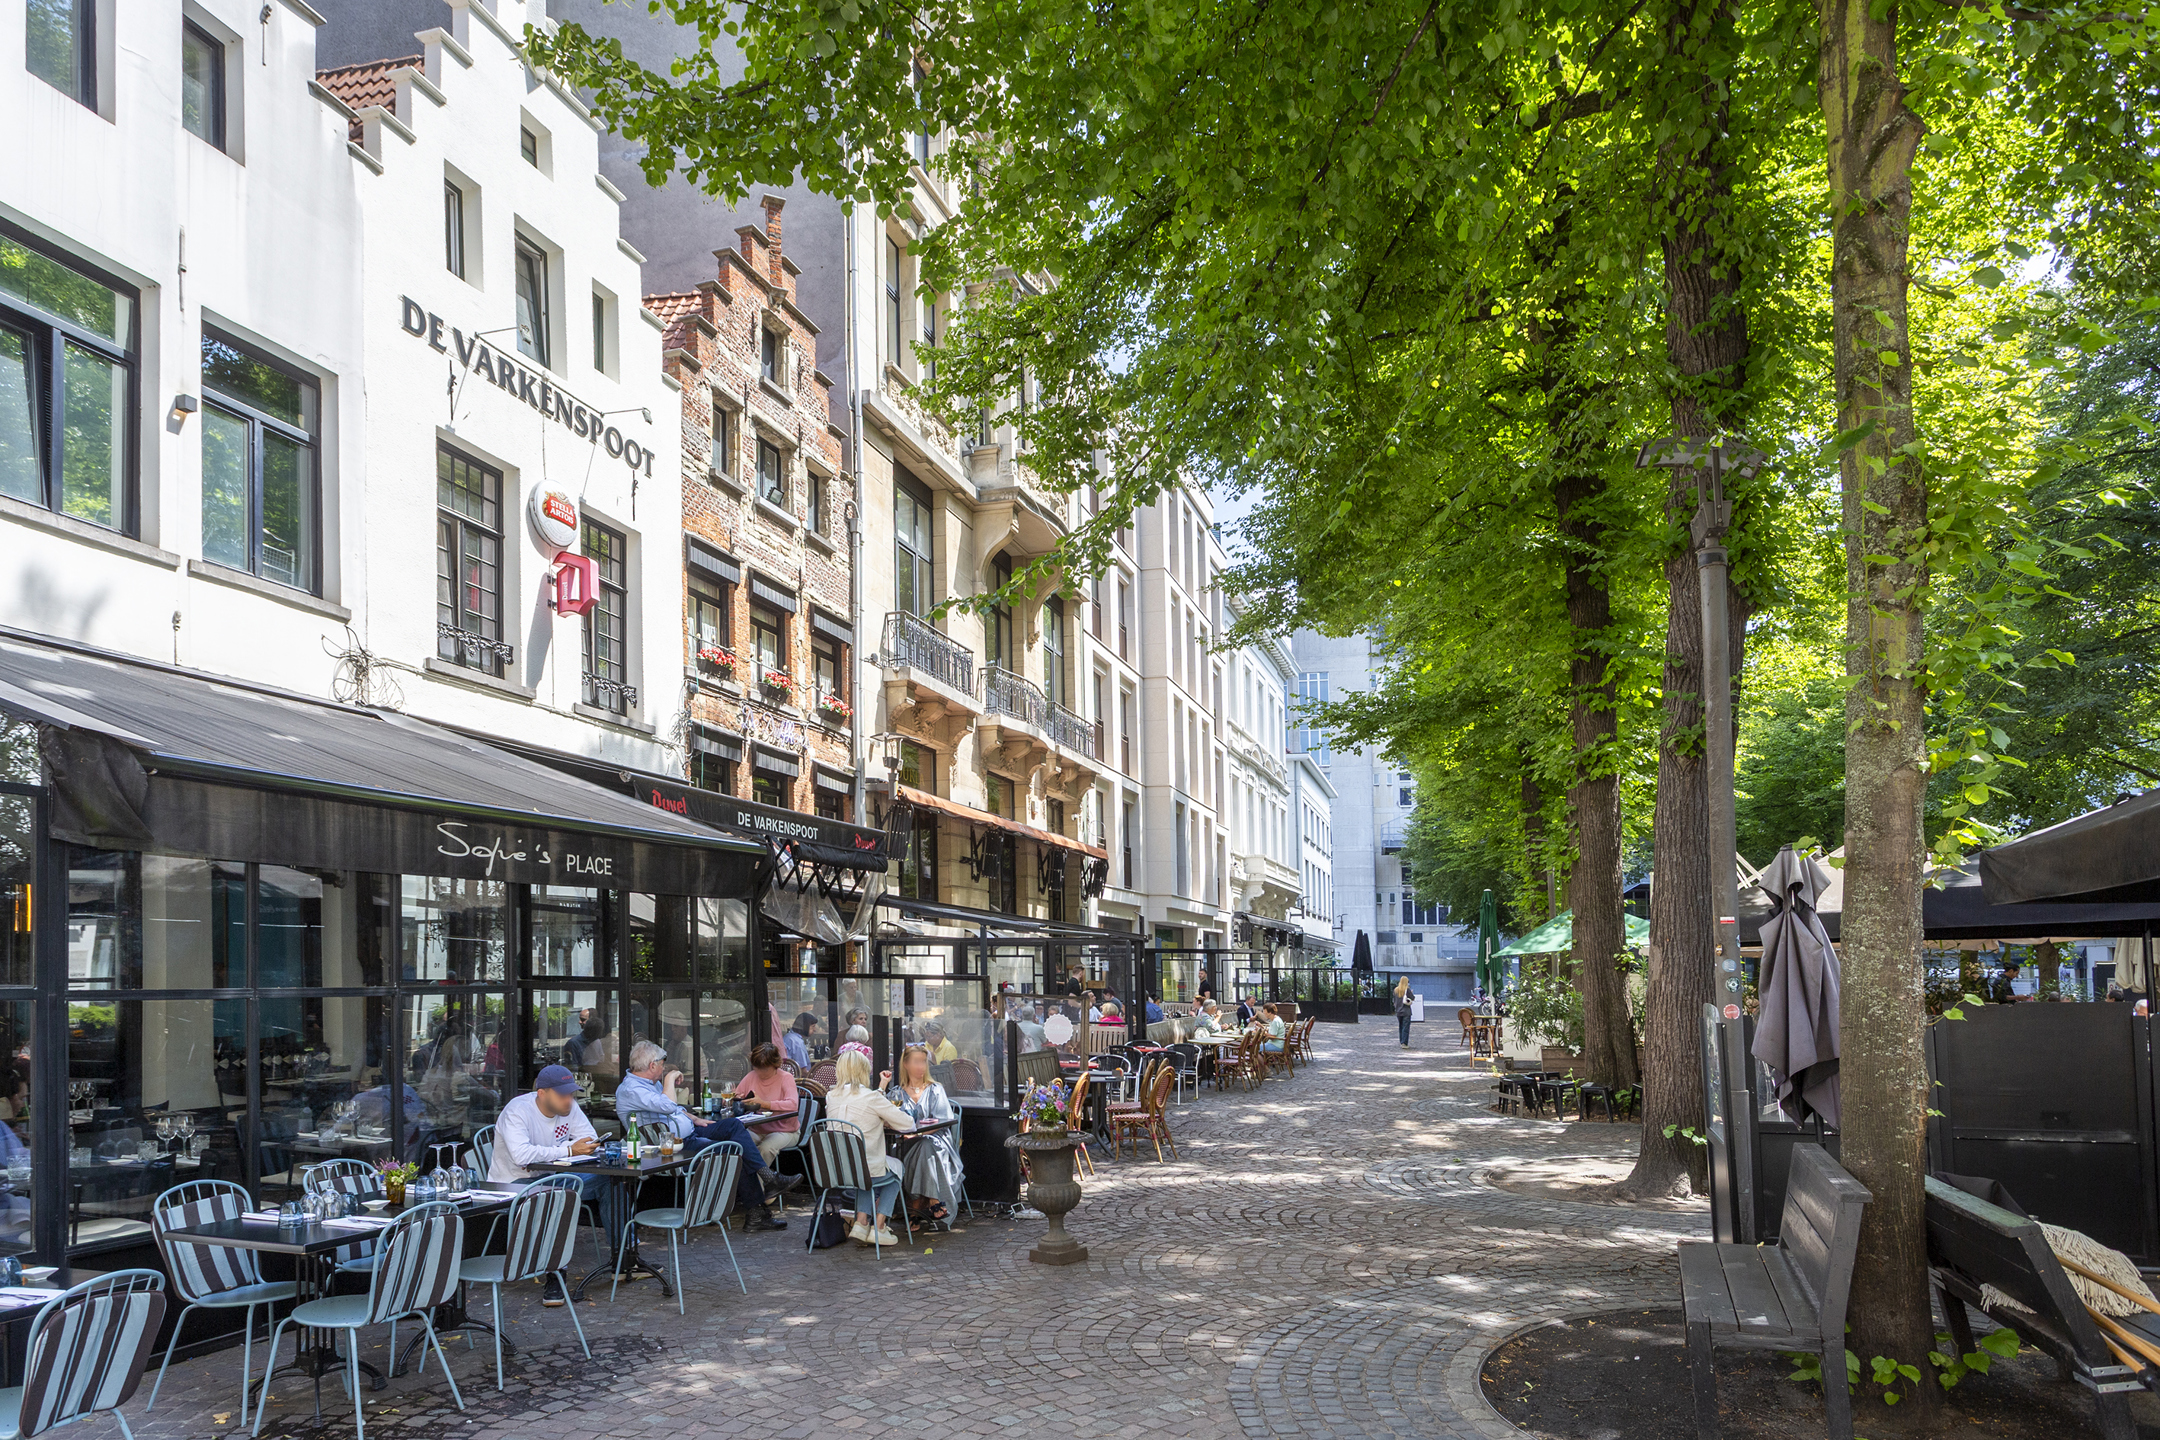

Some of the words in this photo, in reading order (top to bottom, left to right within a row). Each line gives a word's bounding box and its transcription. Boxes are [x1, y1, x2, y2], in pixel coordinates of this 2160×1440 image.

[400, 294, 447, 355] DE
[453, 327, 655, 479] VARKENSPOOT
[550, 500, 574, 517] STELLA
[550, 508, 574, 524] ARTOIS
[651, 788, 687, 815] Duvel
[737, 811, 751, 828] DE
[754, 815, 819, 840] VARKENSPOOT
[437, 822, 551, 877] Sofie's
[566, 854, 613, 876] PLACE
[855, 833, 876, 850] Duvel
